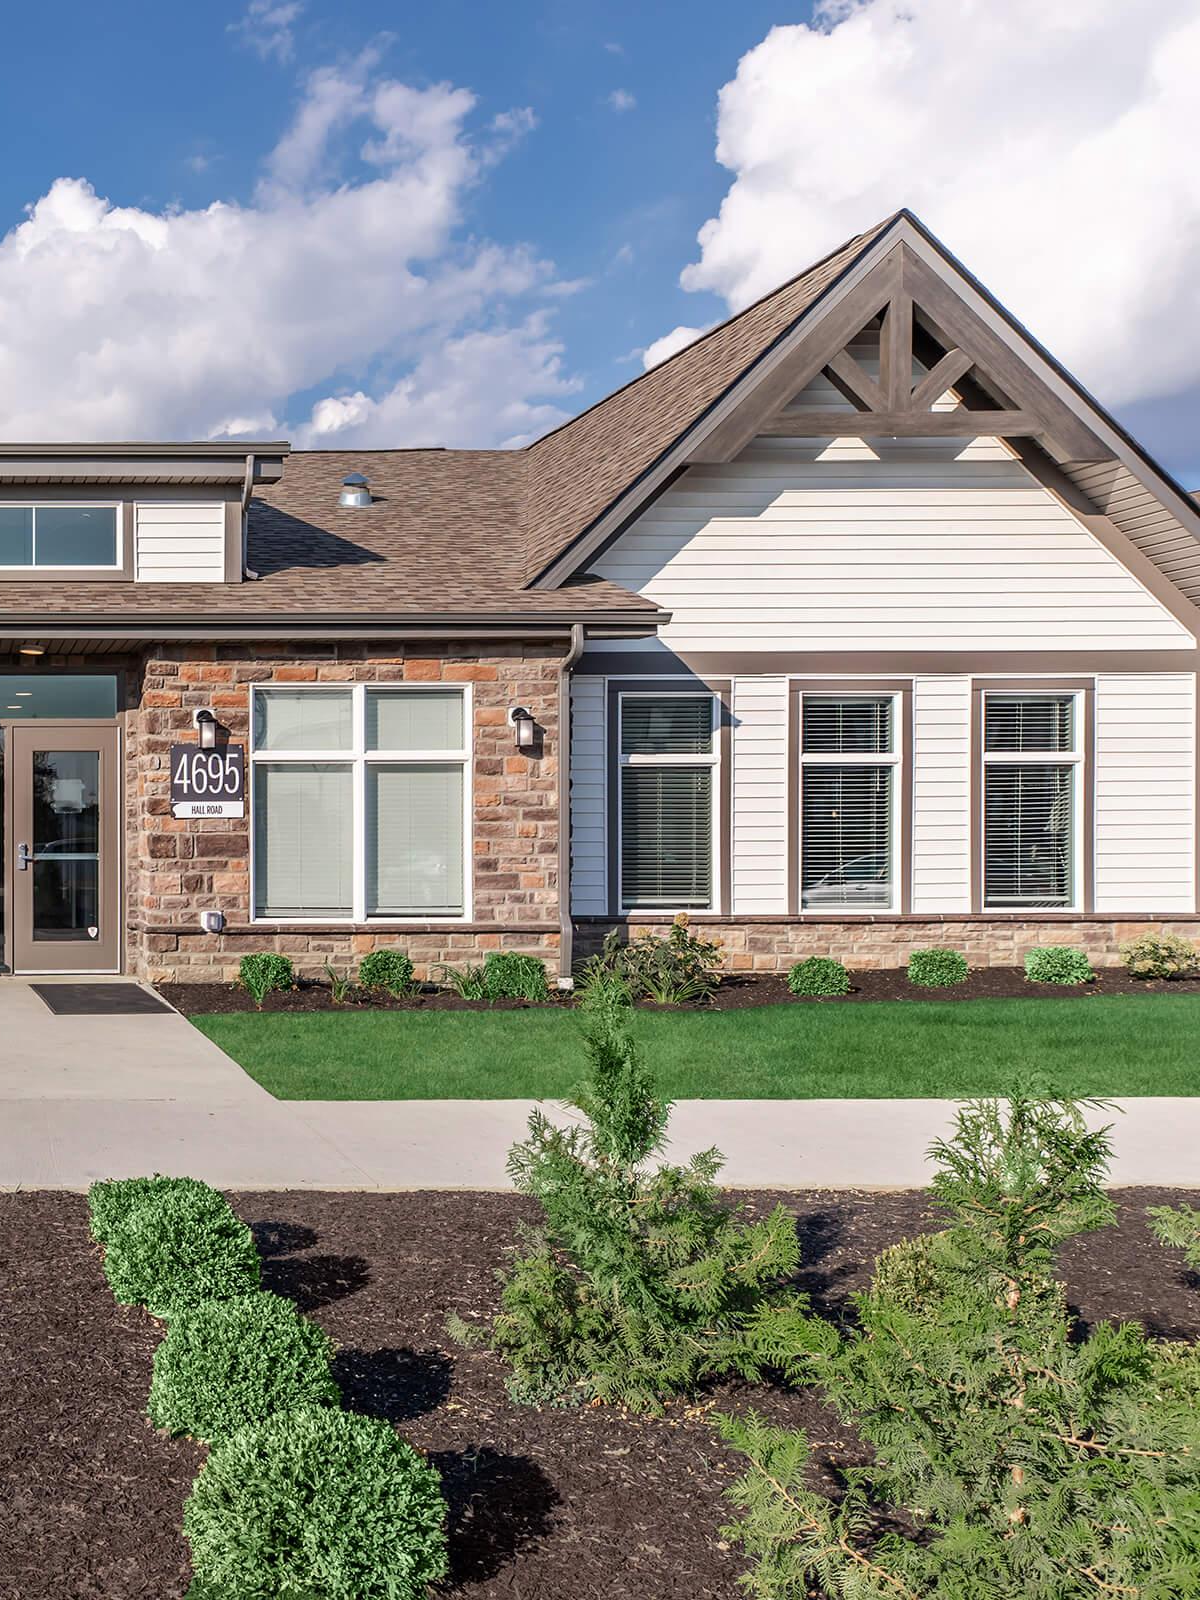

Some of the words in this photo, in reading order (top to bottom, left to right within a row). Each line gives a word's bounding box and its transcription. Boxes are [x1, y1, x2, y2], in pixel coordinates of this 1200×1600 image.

[173, 753, 240, 794] 4695
[191, 805, 205, 815] HALL
[206, 805, 223, 815] ROAD
